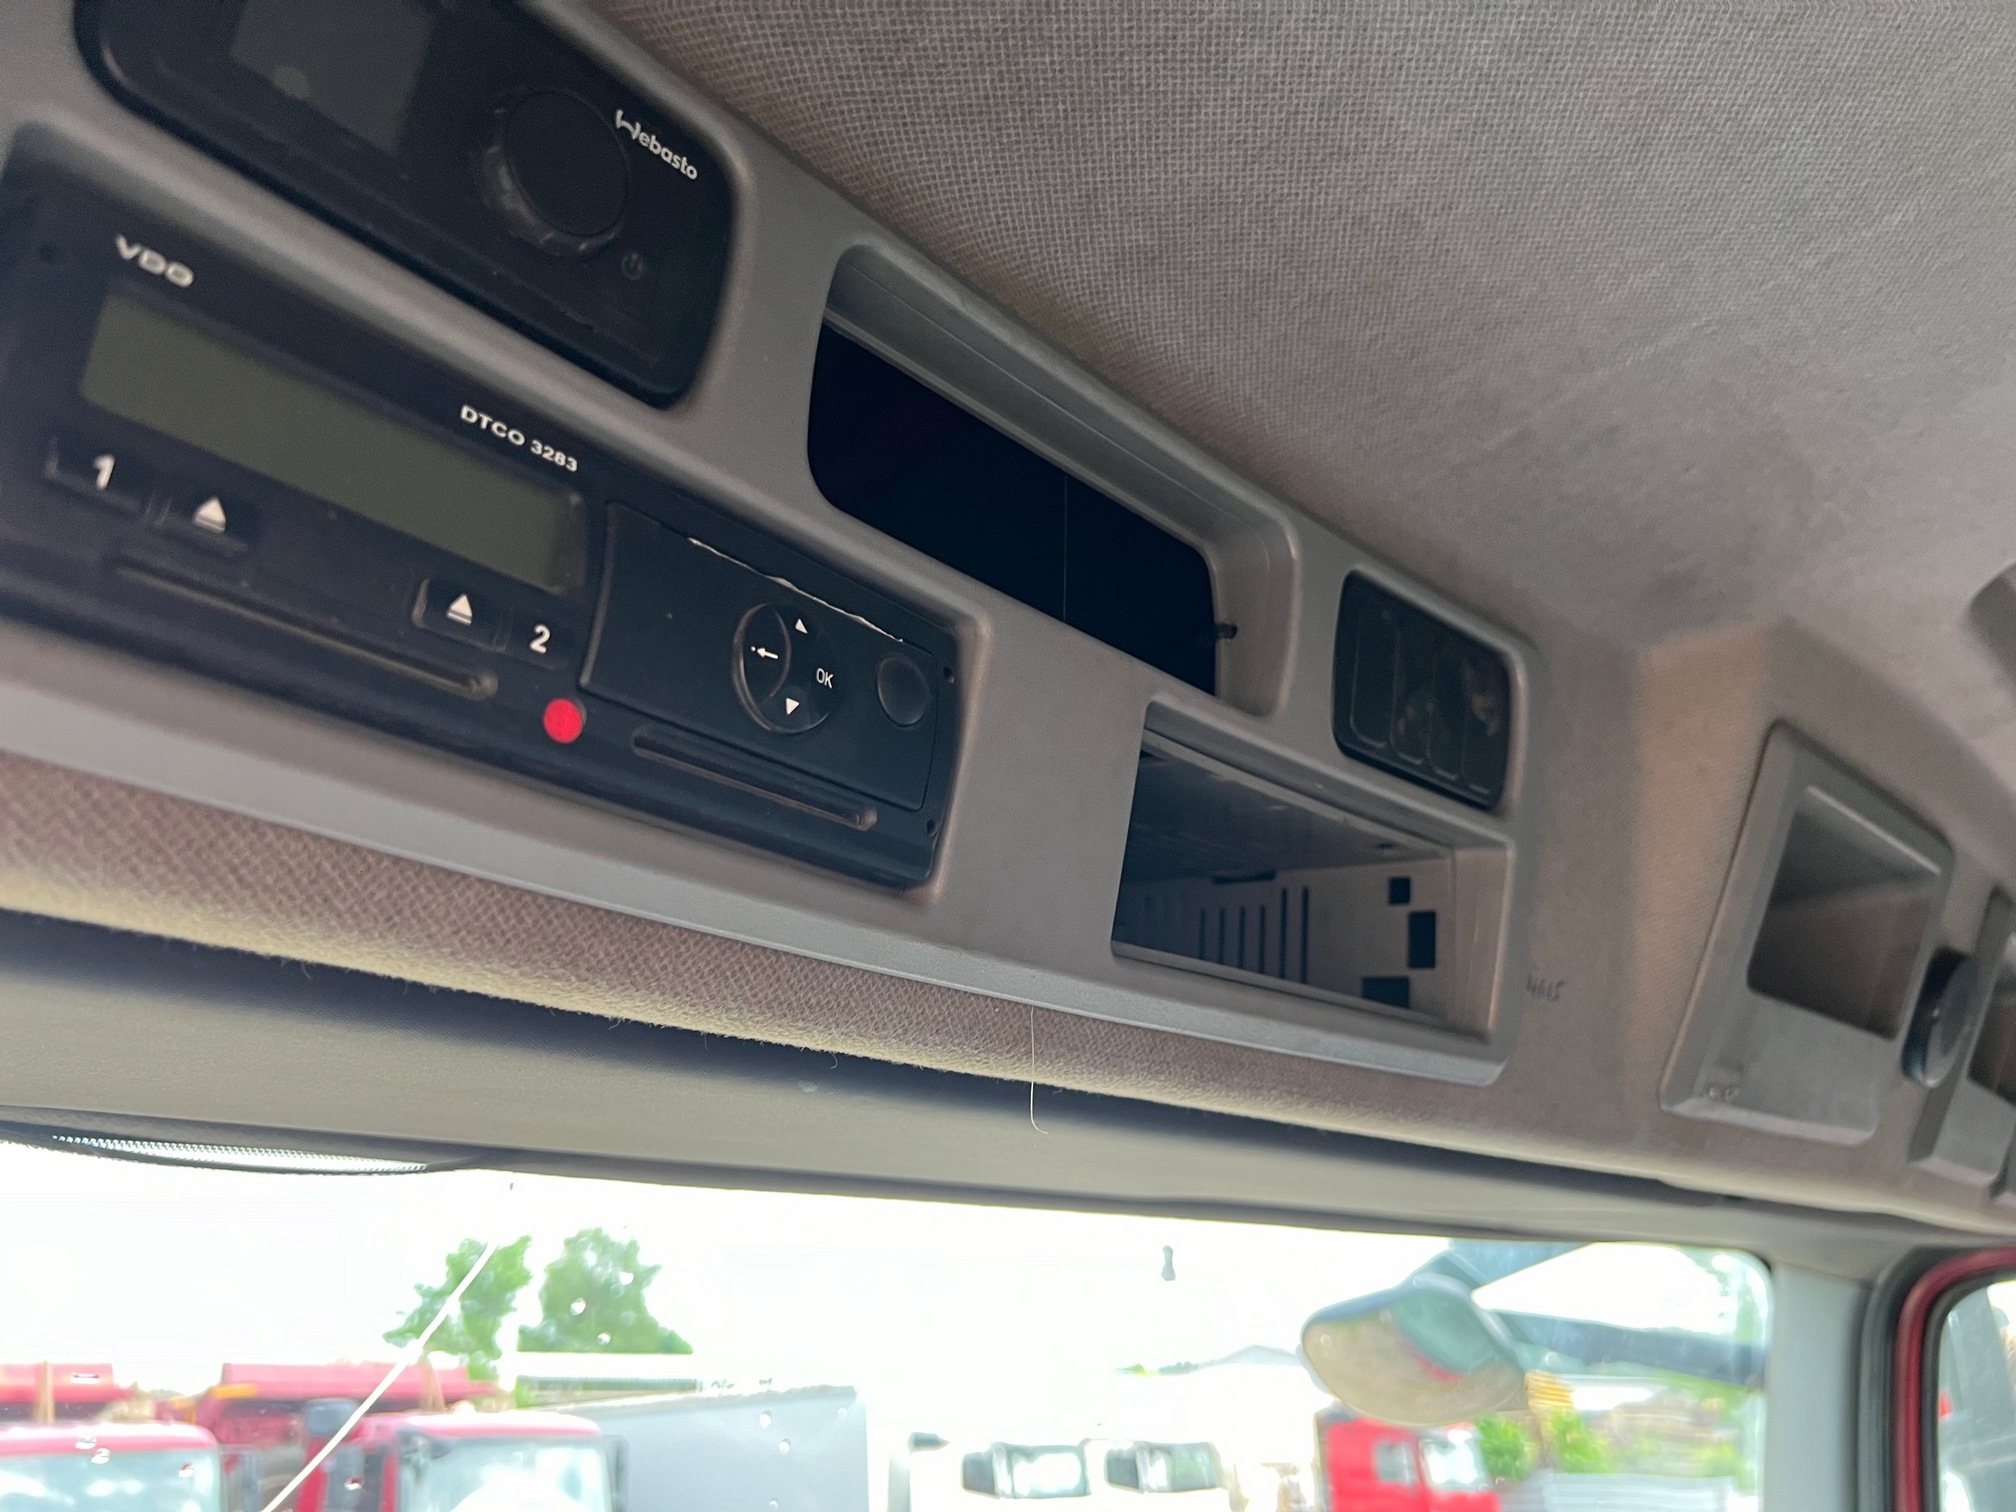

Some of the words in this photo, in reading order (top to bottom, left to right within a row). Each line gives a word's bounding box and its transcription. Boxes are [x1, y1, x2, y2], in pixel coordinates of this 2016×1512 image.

[615, 109, 698, 180] Webasto
[116, 233, 195, 288] VDO
[460, 404, 526, 446] DTCO
[530, 439, 578, 472] 3283
[94, 454, 116, 490] 1
[529, 624, 551, 654] 2
[816, 667, 834, 689] OK
